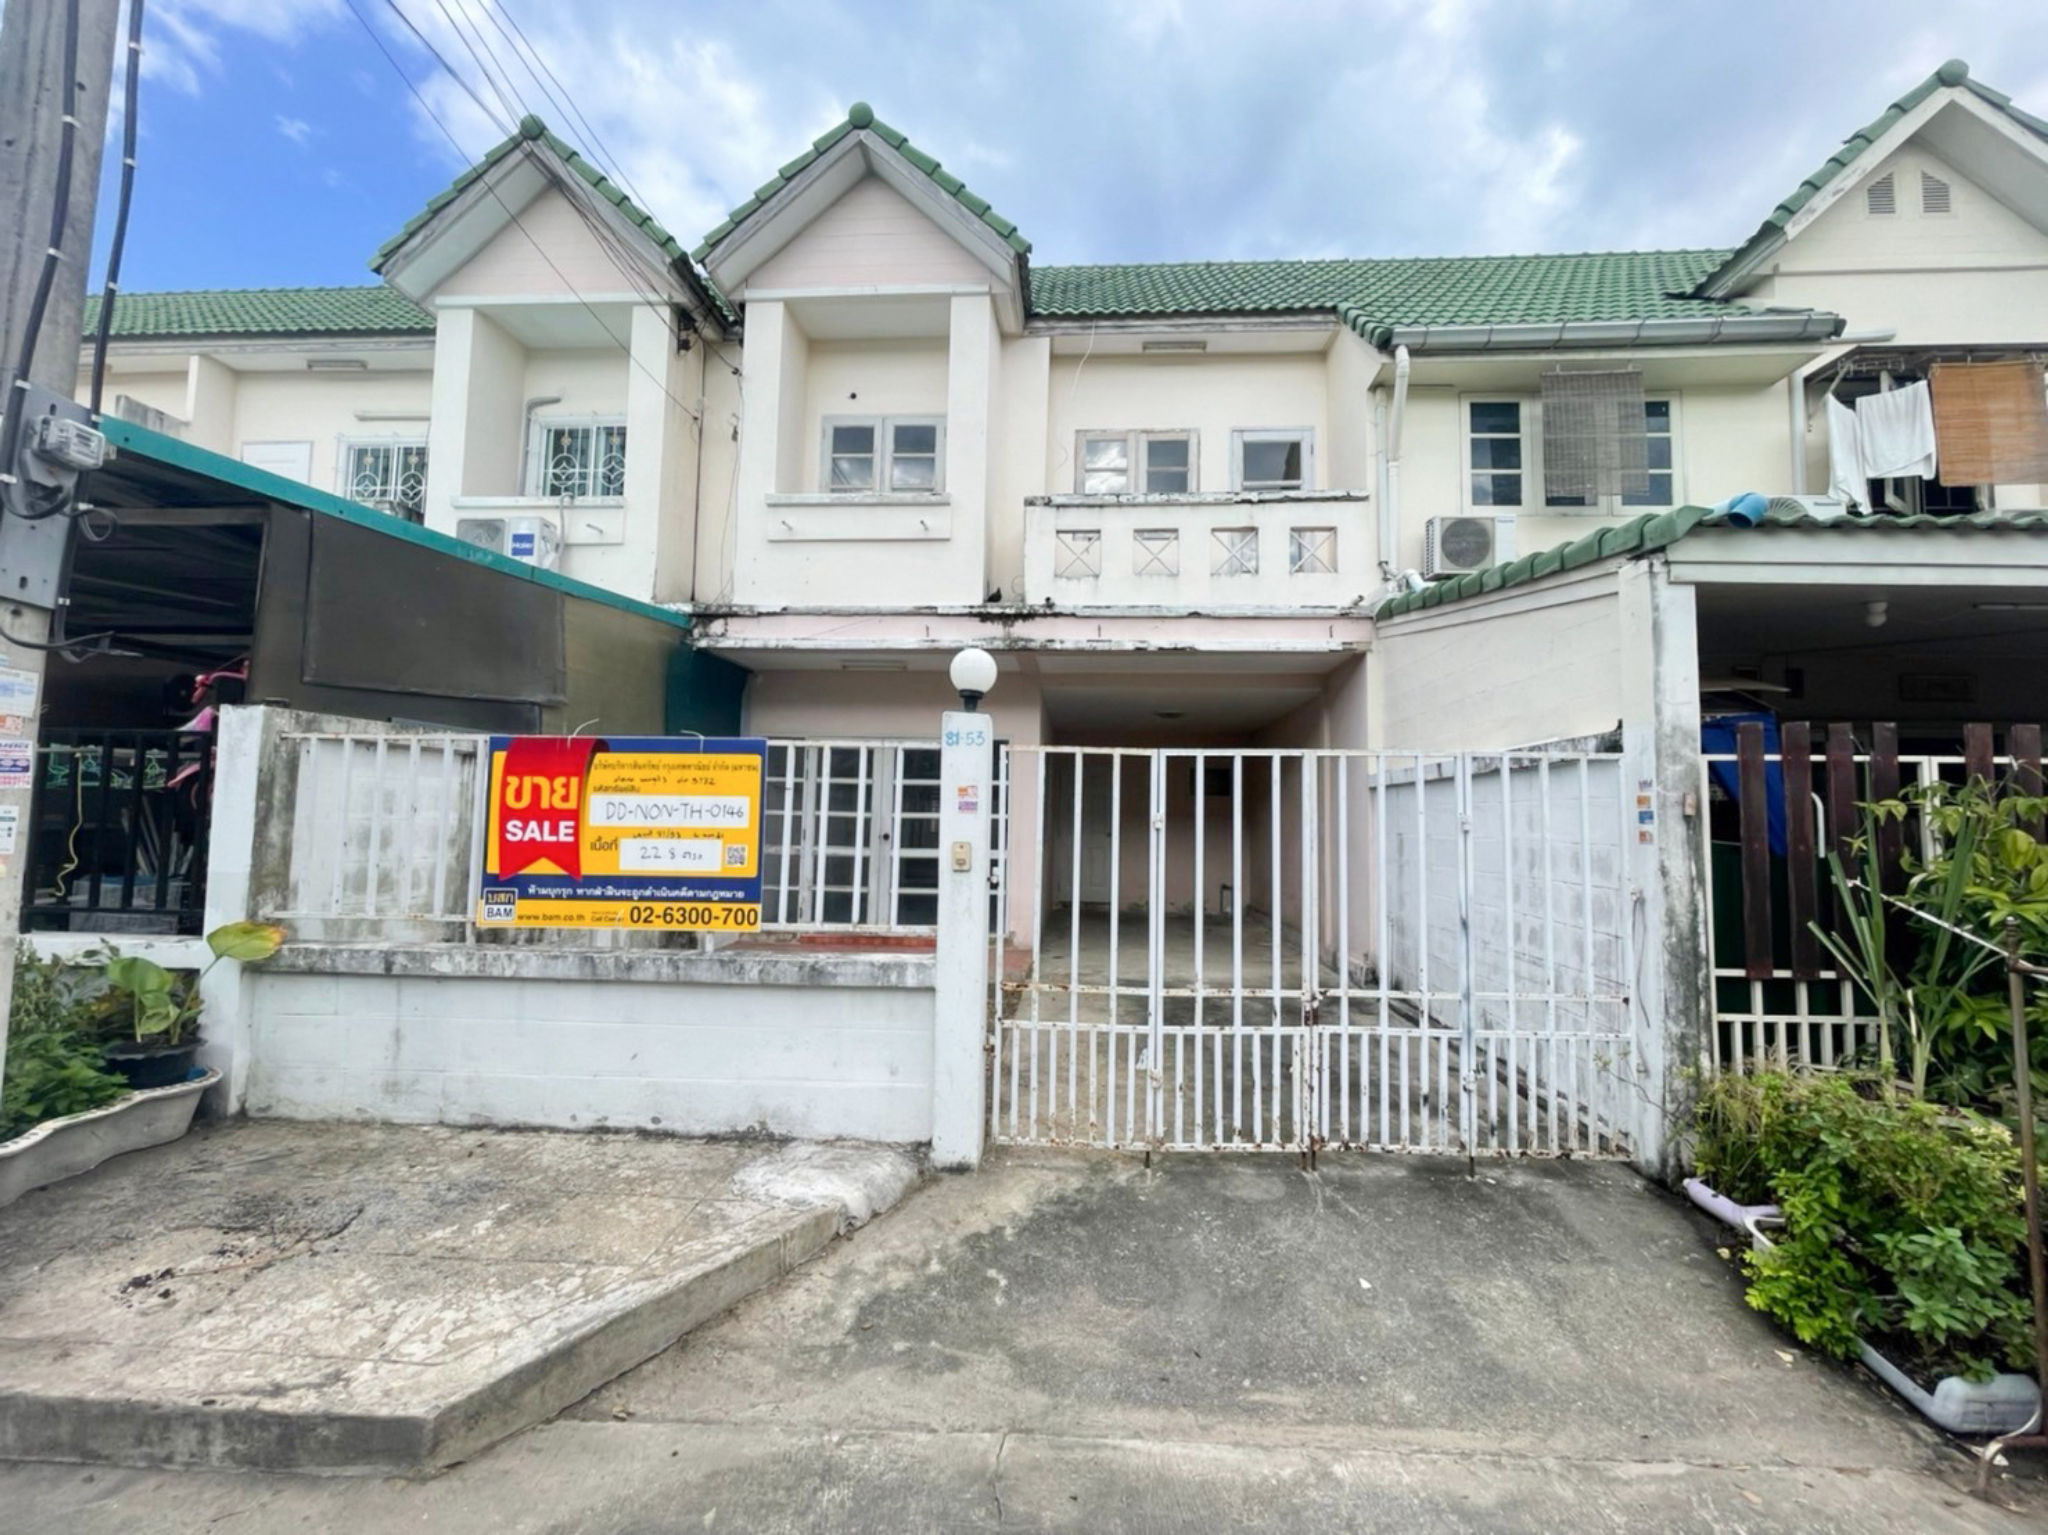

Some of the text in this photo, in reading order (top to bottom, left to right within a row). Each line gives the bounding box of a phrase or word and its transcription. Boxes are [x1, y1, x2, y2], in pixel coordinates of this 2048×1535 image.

[505, 775, 579, 810] ขาย
[505, 819, 575, 842] SALE
[590, 836, 619, 851] เนื้อที่
[487, 907, 513, 918] BAM
[518, 913, 585, 921] www.bam.co.th
[630, 906, 759, 926] 02-6300-700
